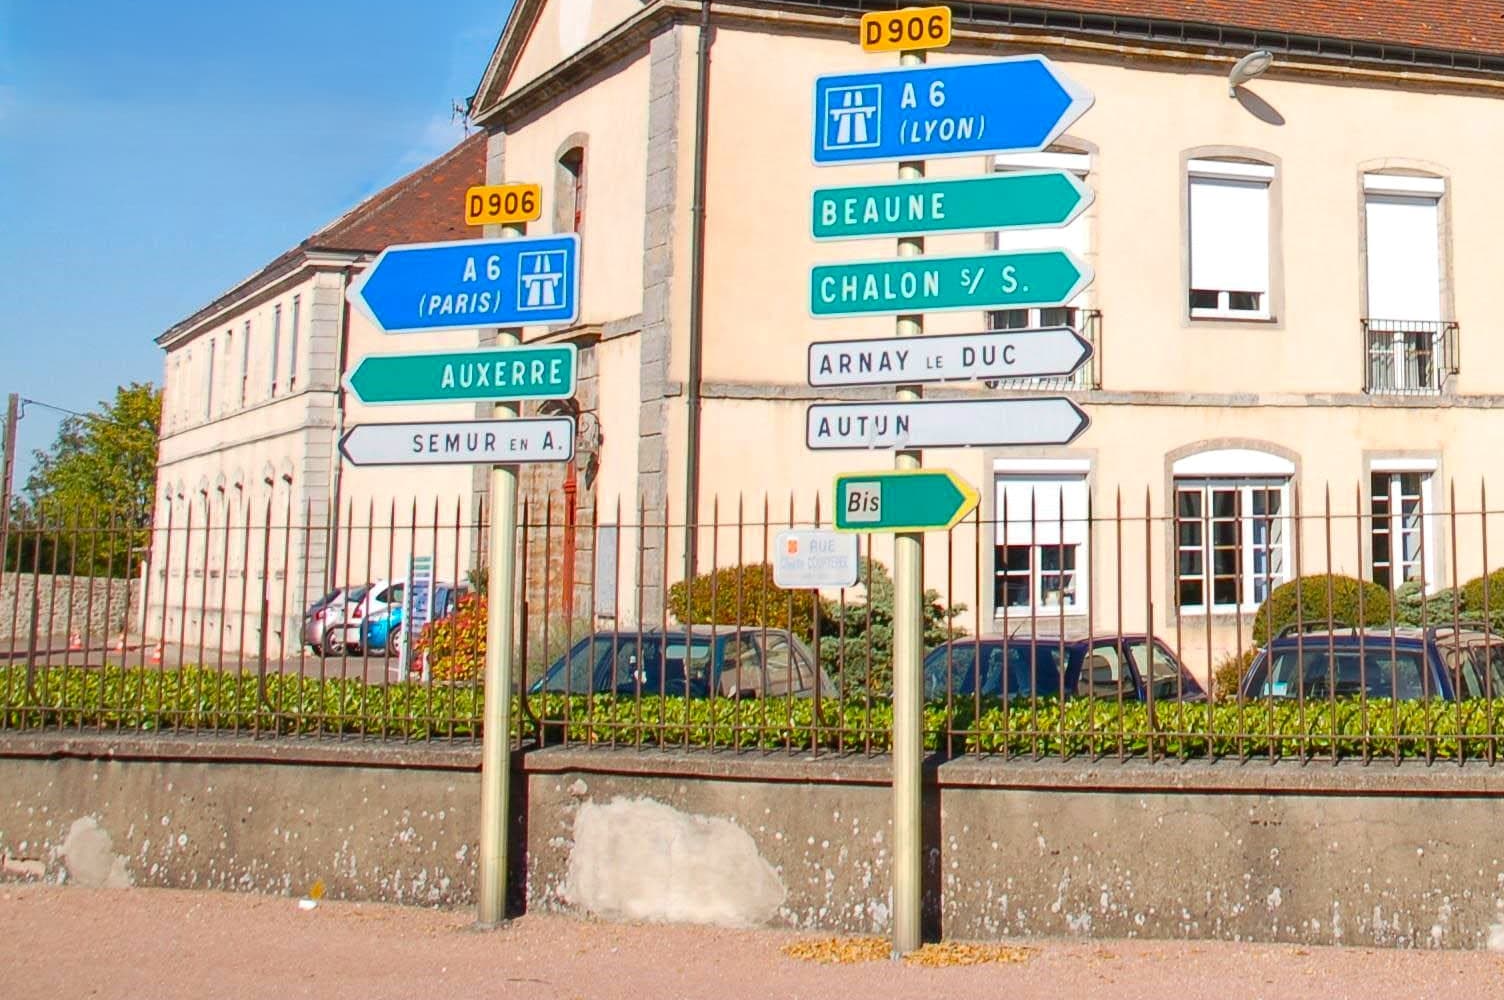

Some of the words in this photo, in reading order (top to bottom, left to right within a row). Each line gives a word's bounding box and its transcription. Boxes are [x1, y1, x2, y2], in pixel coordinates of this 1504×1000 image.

[866, 15, 944, 45] D906
[900, 82, 917, 109] A
[929, 81, 946, 107] 6
[899, 115, 985, 144] (LYON)
[469, 190, 536, 218] D906
[821, 192, 946, 226] BEAUNE
[462, 256, 477, 282] A
[486, 255, 501, 280] 6
[820, 270, 940, 303] CHALON
[1001, 265, 1029, 293] S.
[419, 292, 501, 318] (PARIS)
[441, 358, 563, 389] AUXERRE
[819, 350, 909, 375] ARNAY
[926, 355, 944, 369] LE
[962, 344, 1017, 368] DUC
[818, 414, 910, 438] AUTUN
[412, 432, 497, 454] SEMUR
[509, 438, 528, 451] EN
[542, 431, 563, 451] A.
[847, 491, 880, 513] Bis
